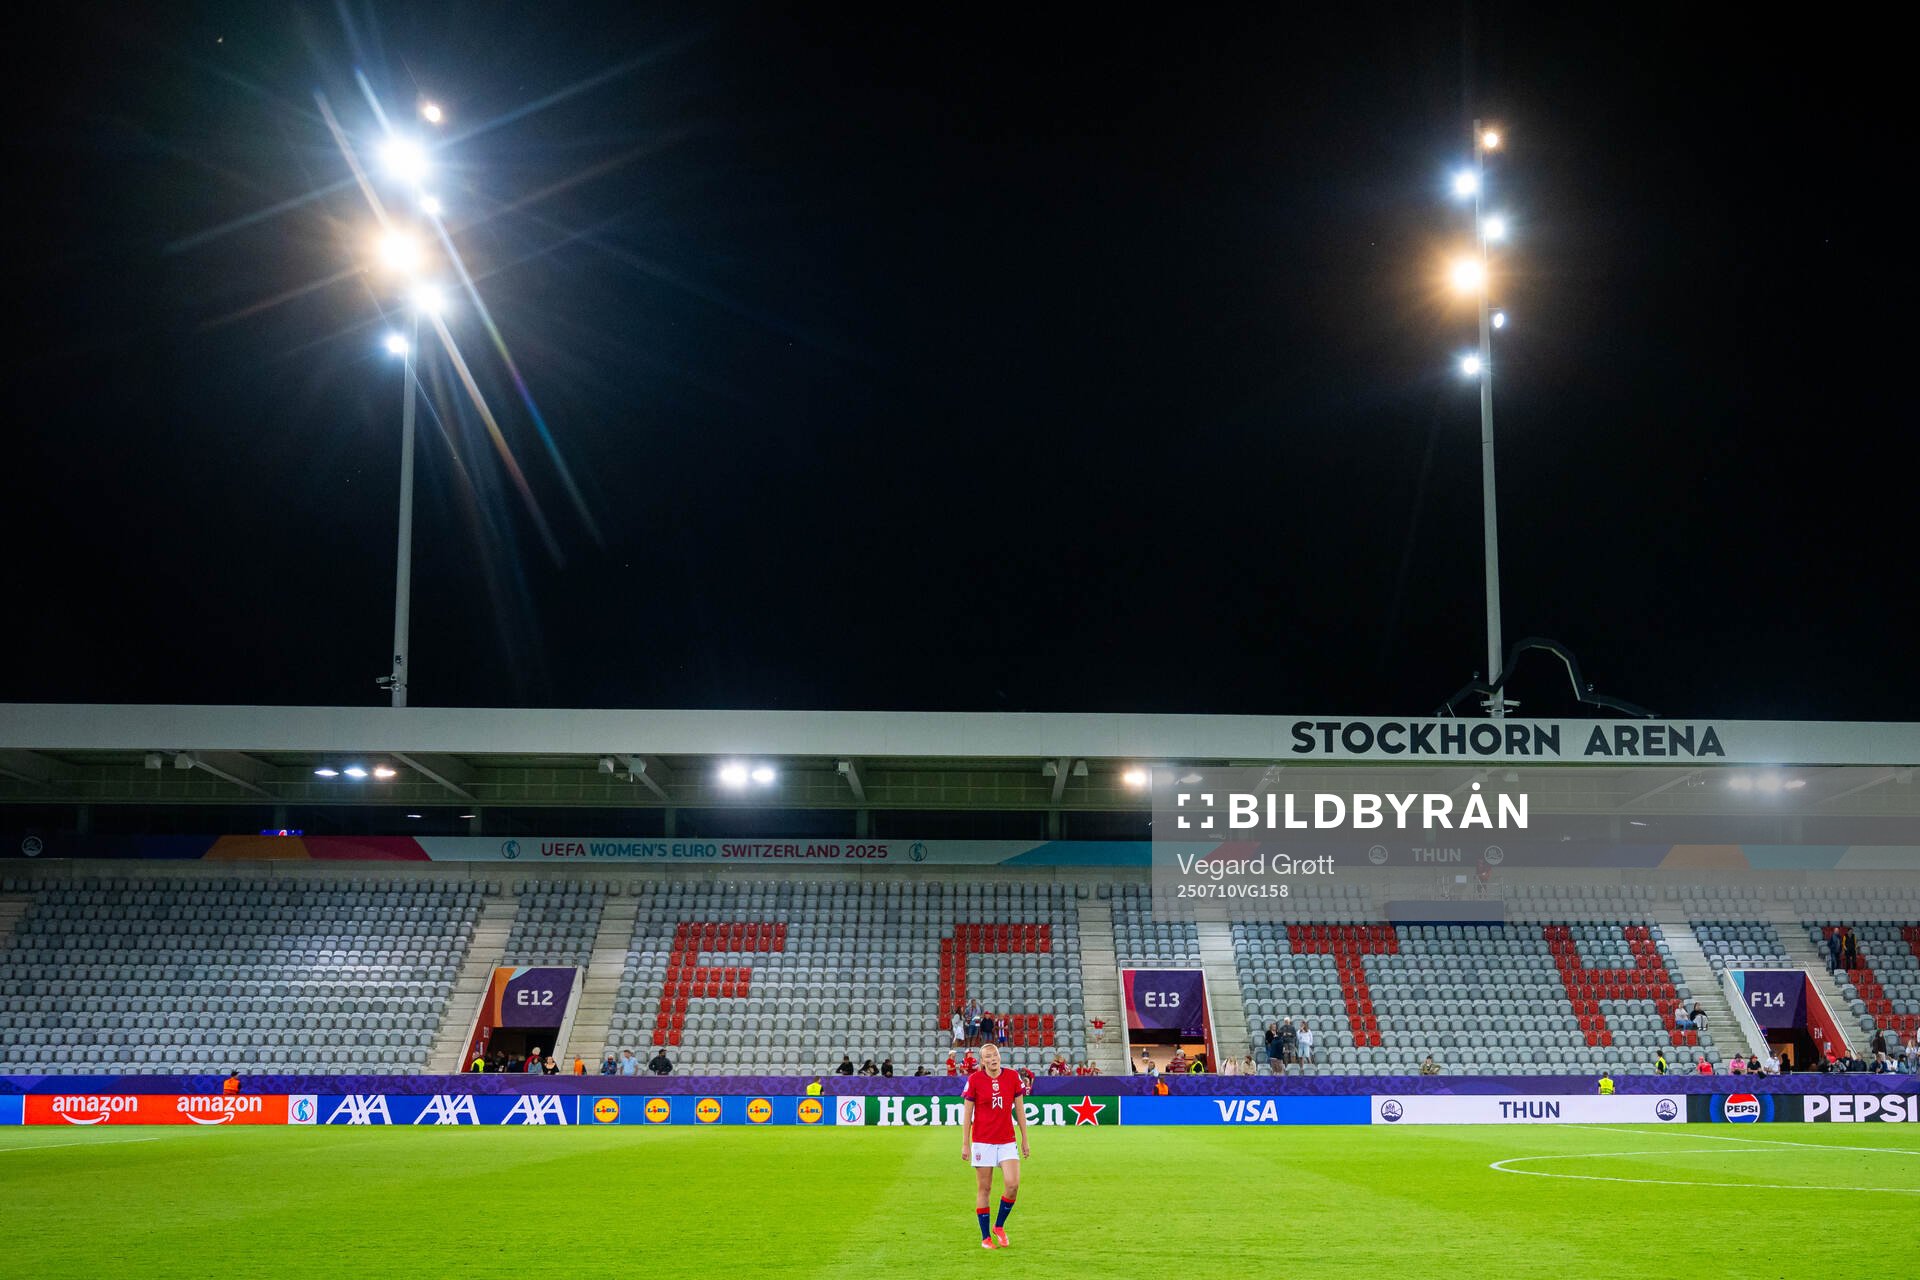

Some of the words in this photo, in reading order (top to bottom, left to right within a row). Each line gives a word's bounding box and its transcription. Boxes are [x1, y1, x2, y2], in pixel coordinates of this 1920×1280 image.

[1290, 721, 1562, 757] STOCKHORN
[1583, 724, 1727, 757] ARENA
[541, 843, 587, 857] UEFA
[590, 842, 668, 858] WOMEN'S
[672, 843, 717, 858] EURO
[721, 843, 841, 858] SWITZERLAND
[845, 844, 888, 858] 2025
[1411, 847, 1462, 863] THUN
[516, 989, 554, 1006] E12
[1144, 991, 1181, 1008] E13
[1751, 992, 1785, 1008] F14
[52, 1095, 138, 1113] amazon
[176, 1095, 262, 1113] amazon
[325, 1094, 393, 1125] AXA
[413, 1094, 481, 1125] AXA
[500, 1094, 568, 1125] AXA
[877, 1096, 1066, 1127] Heinen
[991, 1097, 1003, 1109] 20
[1213, 1100, 1279, 1122] VISA
[1499, 1101, 1560, 1119] THUN
[1727, 1105, 1758, 1113] PEPSI
[1803, 1095, 1918, 1123] PEPSI
